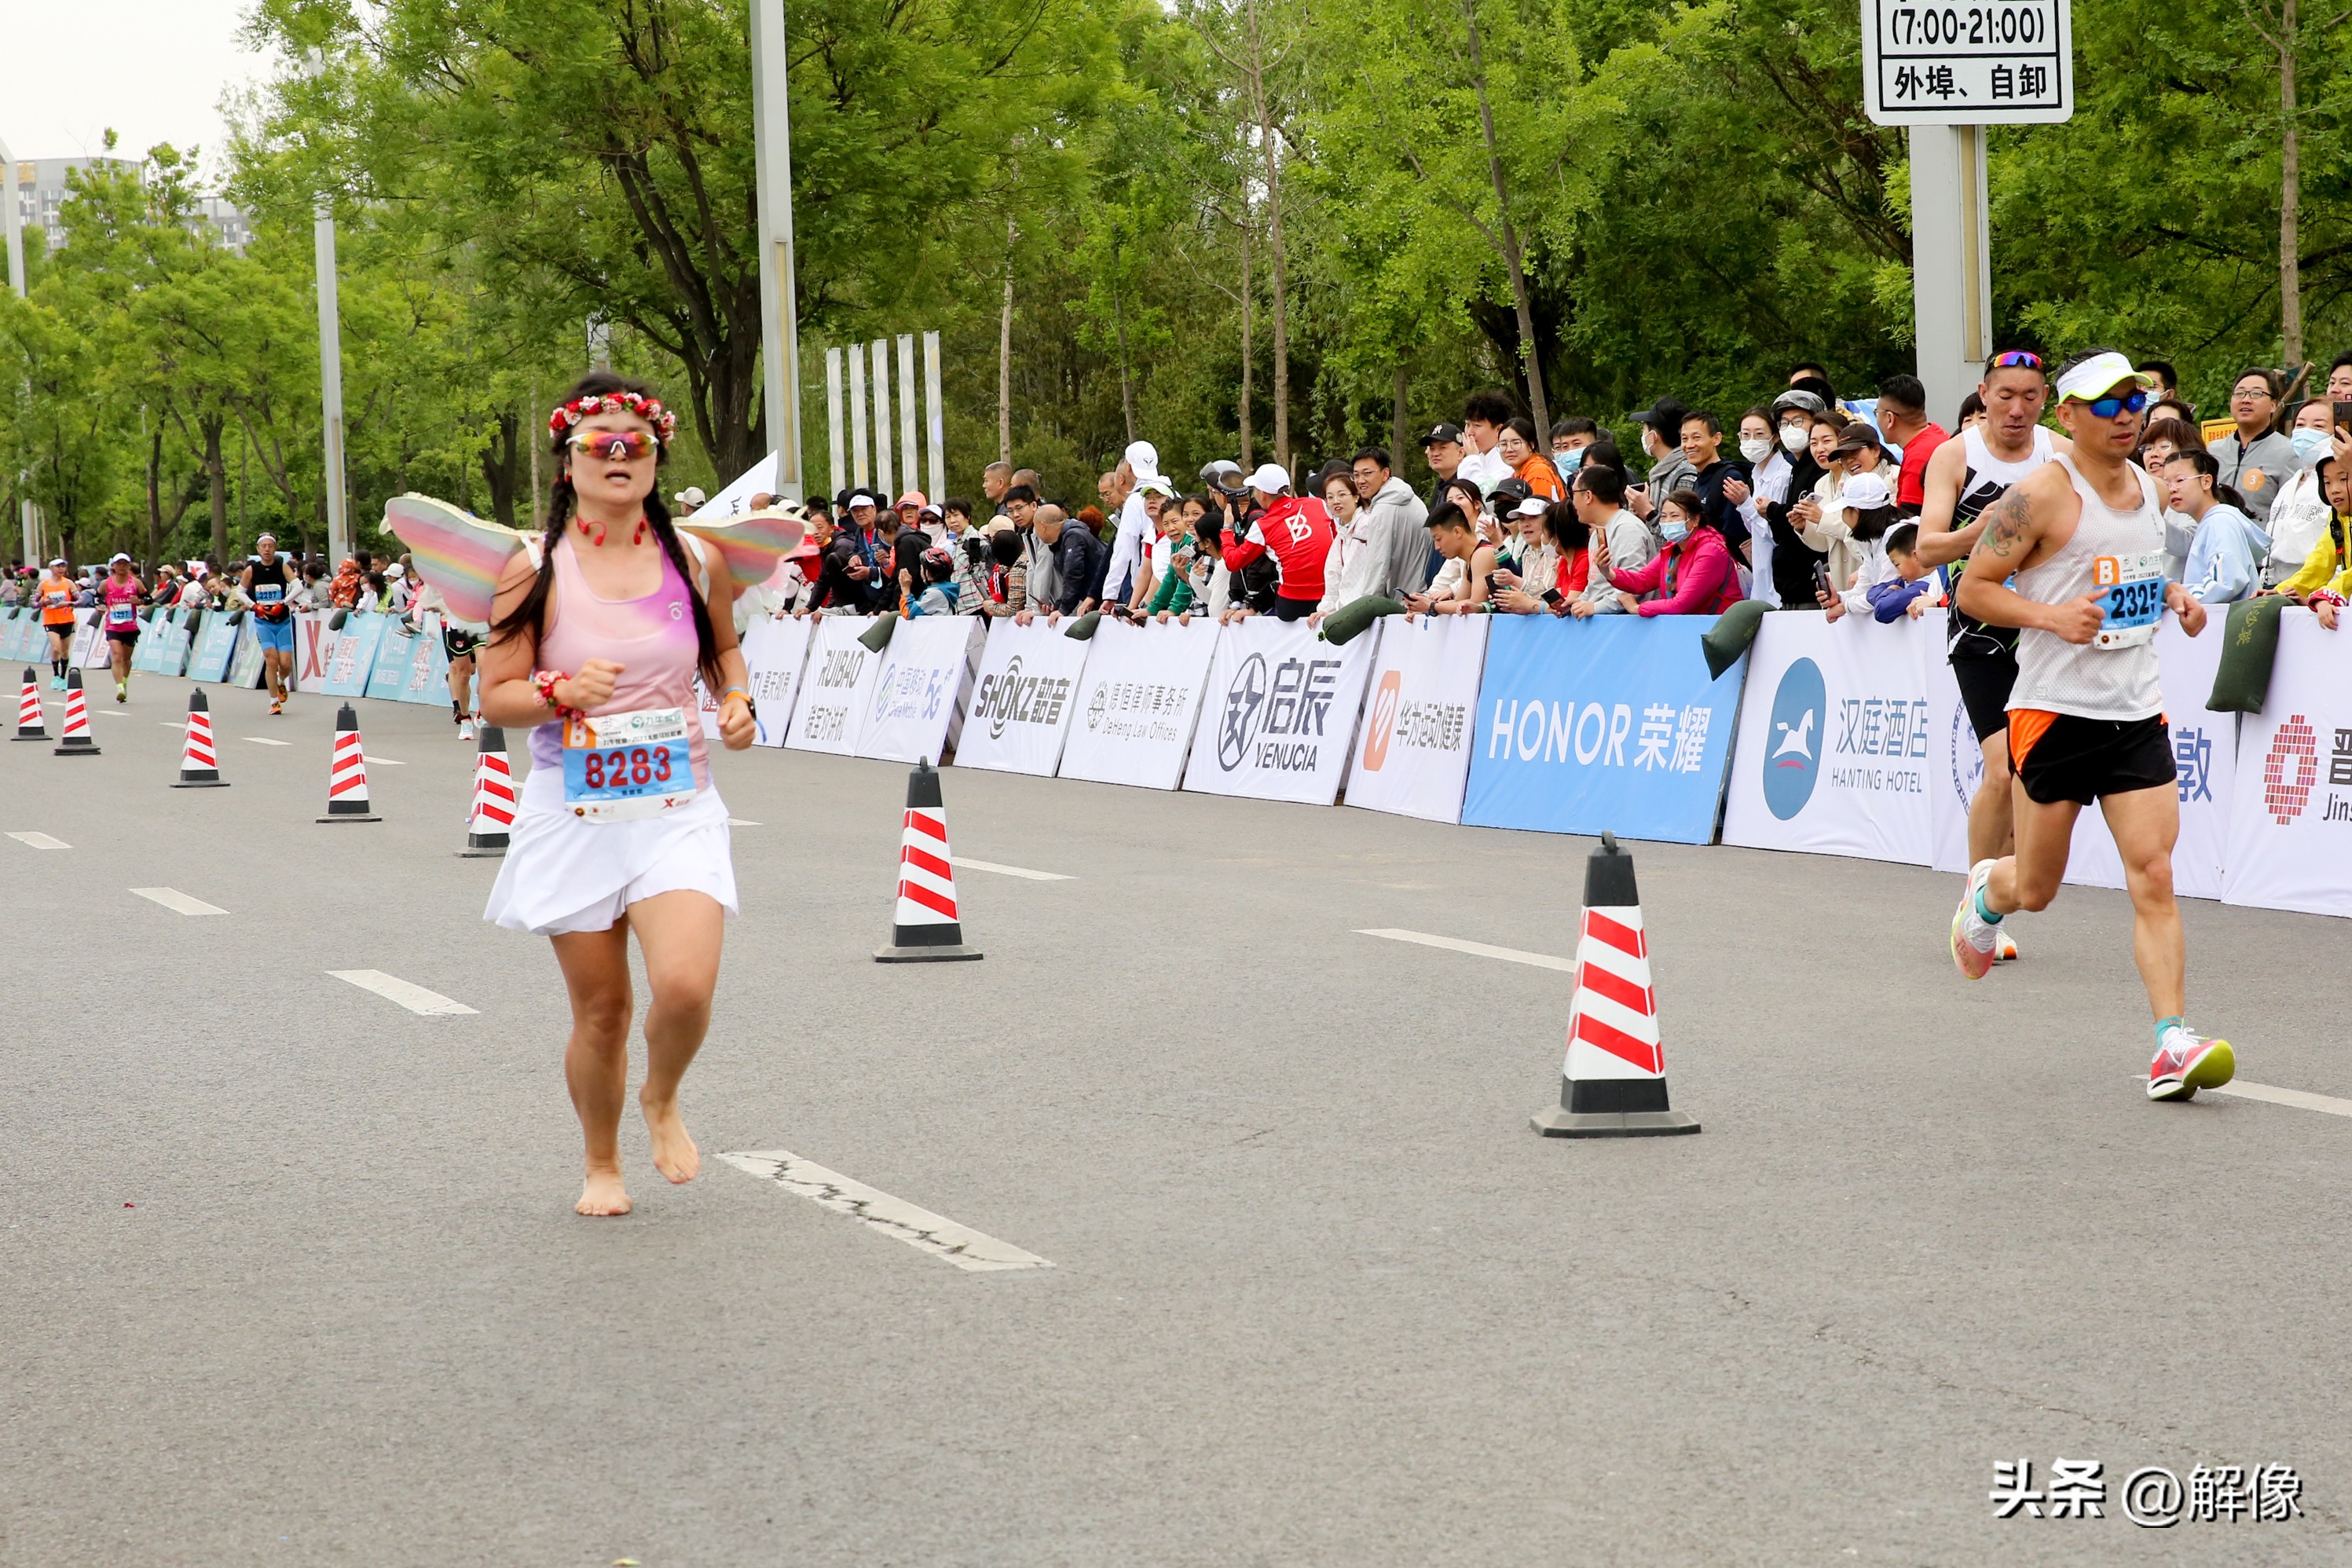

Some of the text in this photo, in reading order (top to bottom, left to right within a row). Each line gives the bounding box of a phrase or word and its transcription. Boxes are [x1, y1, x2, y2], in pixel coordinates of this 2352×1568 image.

[1892, 7, 2044, 45] (7:00-21:00)
[2249, 474, 2256, 485] 3
[2099, 559, 2113, 584] B
[2111, 582, 2158, 619] 2325
[817, 649, 864, 688] RUIBAO
[896, 667, 926, 696] 中国移动
[975, 669, 1071, 726] SHOKZ 韶音
[1108, 680, 1189, 716] 德恒律师事务所
[1262, 657, 1343, 737] 启辰
[570, 720, 588, 748] B
[1103, 716, 1178, 742] DeHeng Law Offices
[1396, 702, 1466, 752] 华为运动健康
[1488, 698, 1712, 774] HONOR 荣耀
[1836, 695, 1929, 759] 汉庭酒店
[585, 746, 672, 789] 8283
[1255, 742, 1318, 772] VENUCIA
[2176, 727, 2213, 804] 敦
[1831, 767, 1922, 793] HANTING HOTEL
